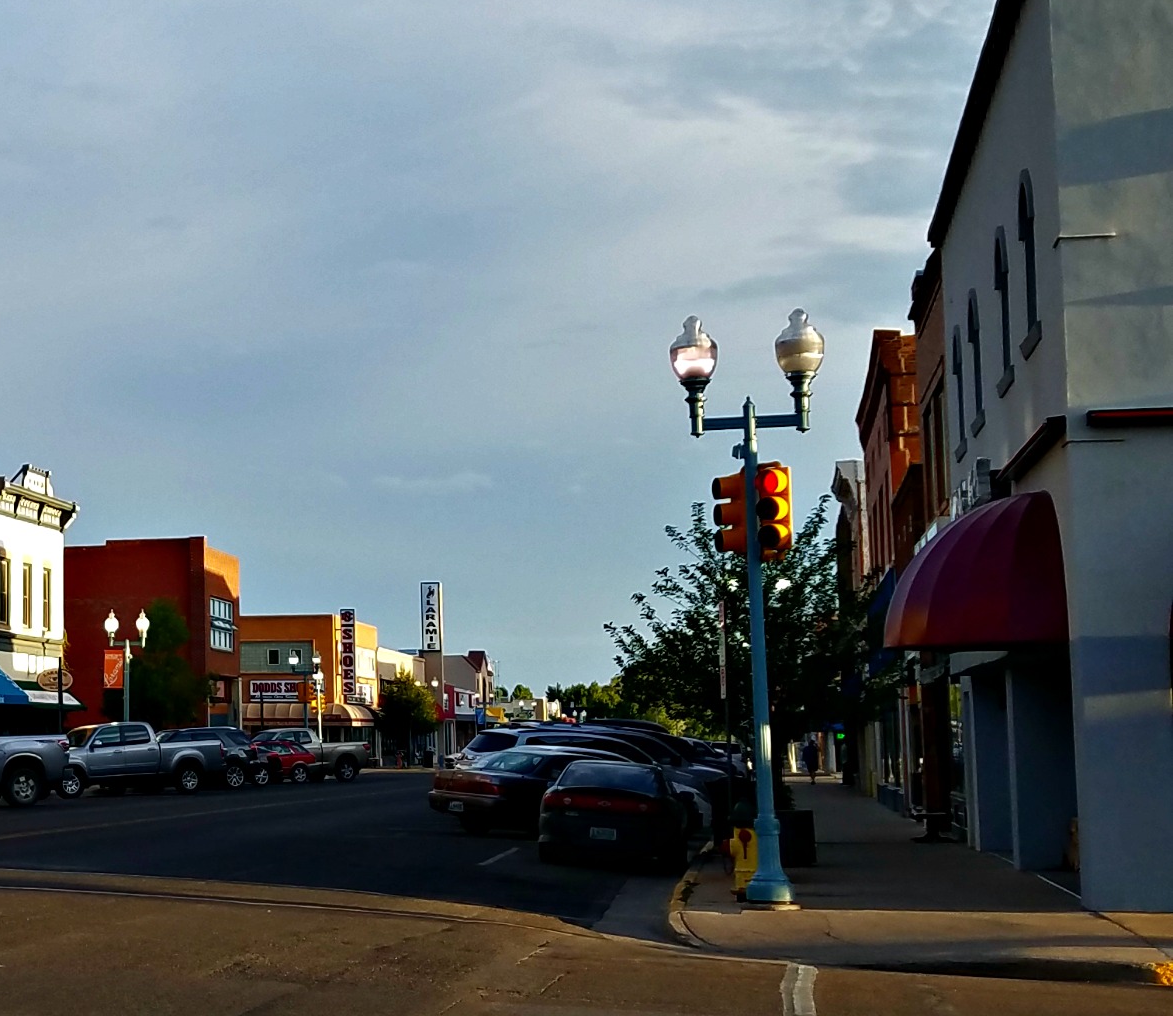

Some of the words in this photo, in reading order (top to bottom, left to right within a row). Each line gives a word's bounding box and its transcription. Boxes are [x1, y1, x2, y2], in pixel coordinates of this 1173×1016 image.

[425, 600, 437, 649] LARAMIE
[342, 628, 354, 694] SHOES
[252, 682, 282, 693] DODDS
